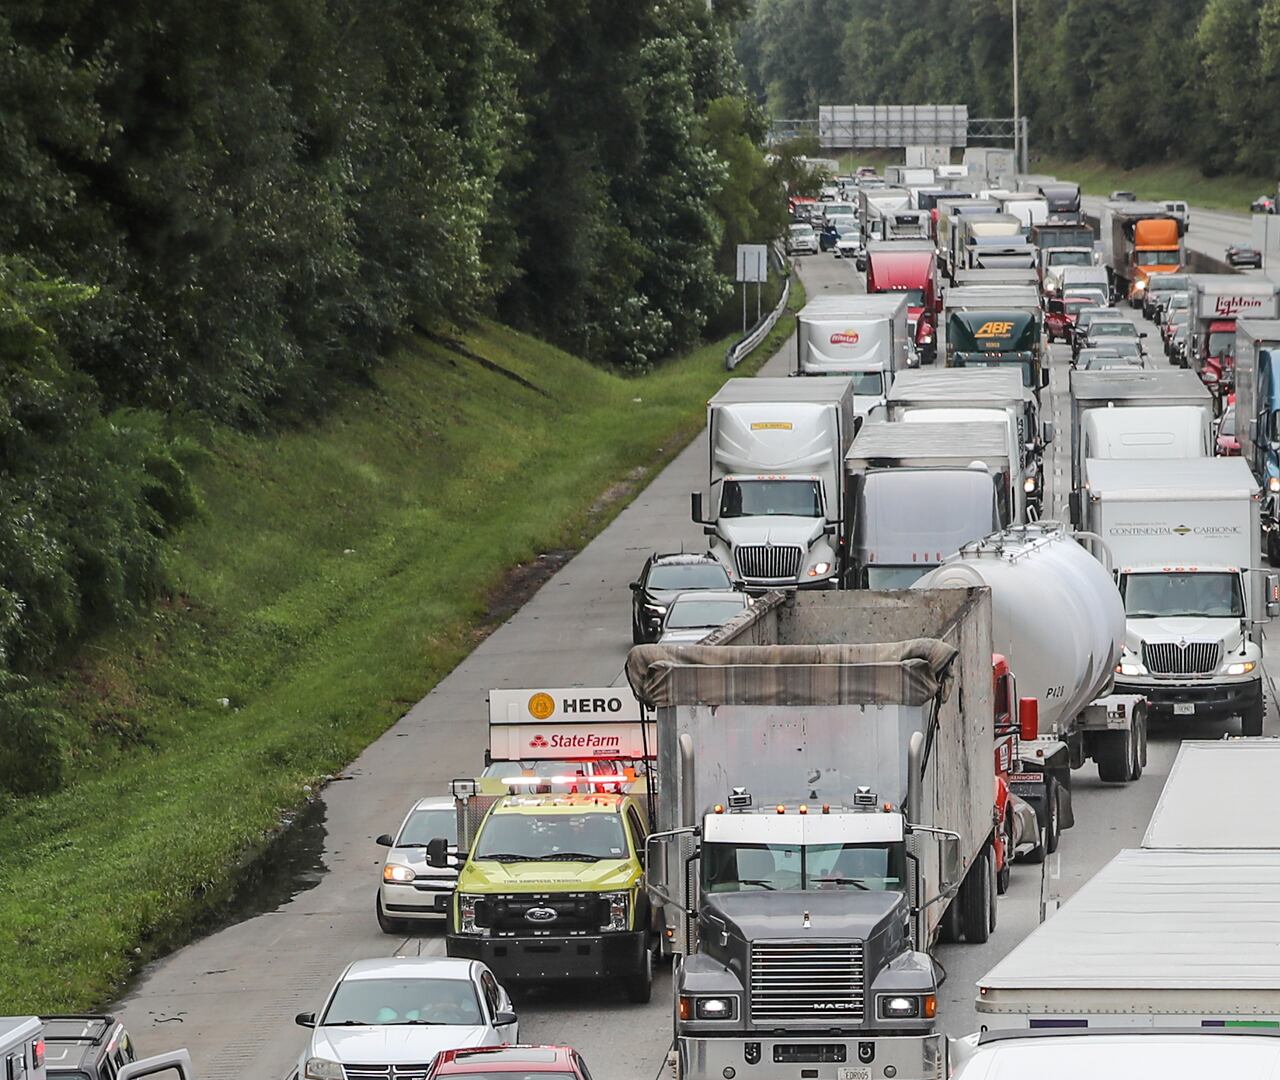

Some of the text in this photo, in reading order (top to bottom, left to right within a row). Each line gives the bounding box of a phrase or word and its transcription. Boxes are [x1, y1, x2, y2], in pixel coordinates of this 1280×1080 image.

[977, 321, 1015, 334] ABF
[1109, 526, 1240, 536] CONTINENTAL CARBONIC
[563, 698, 622, 713] HERO
